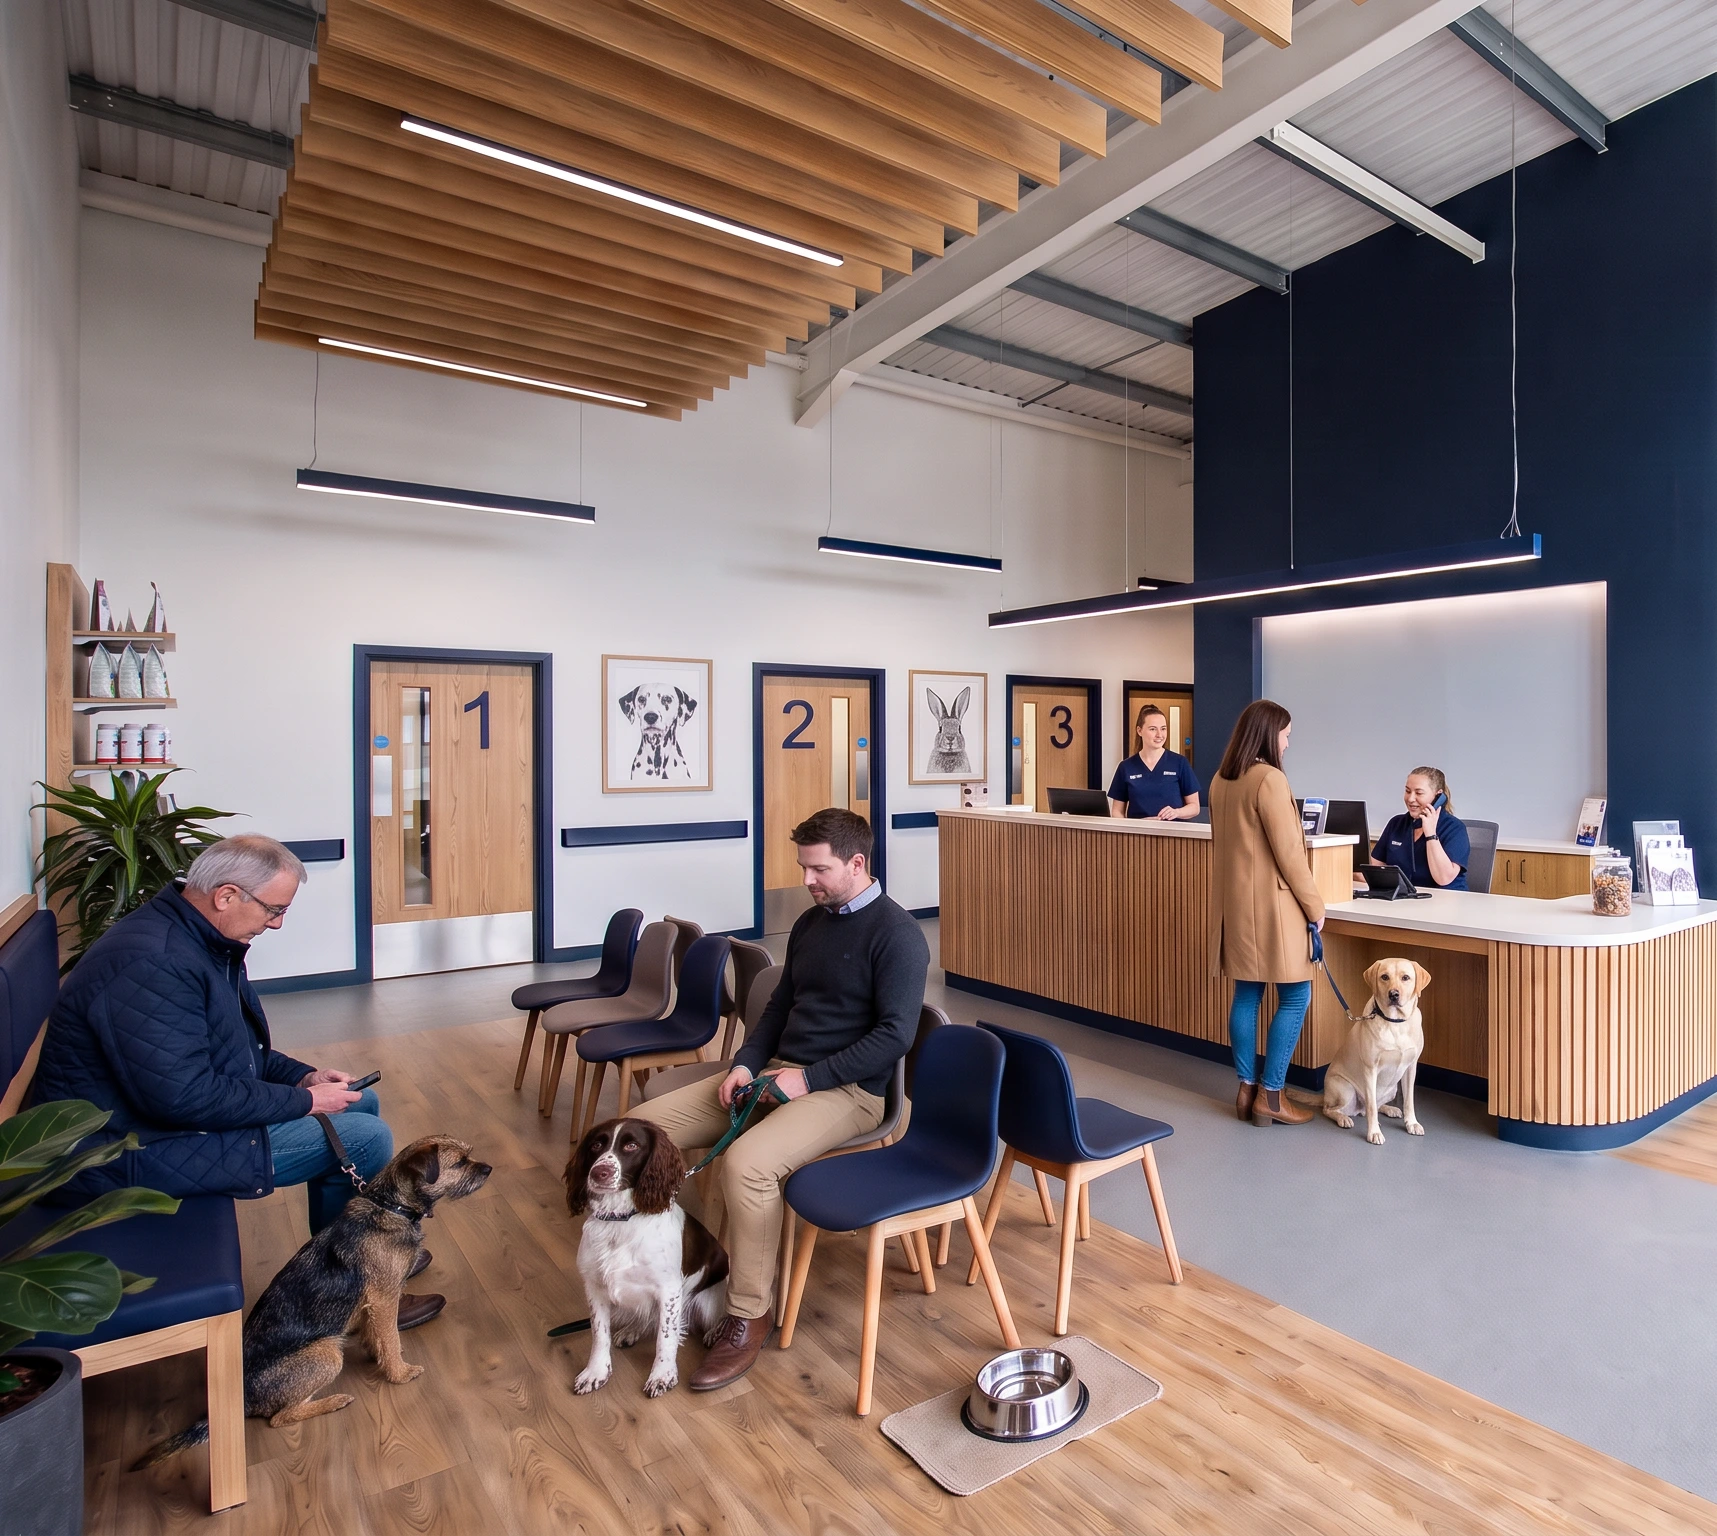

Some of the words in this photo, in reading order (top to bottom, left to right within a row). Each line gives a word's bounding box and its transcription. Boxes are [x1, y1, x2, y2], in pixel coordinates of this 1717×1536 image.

[463, 690, 490, 750] 1
[781, 699, 816, 749] 2
[1049, 705, 1074, 750] 3
